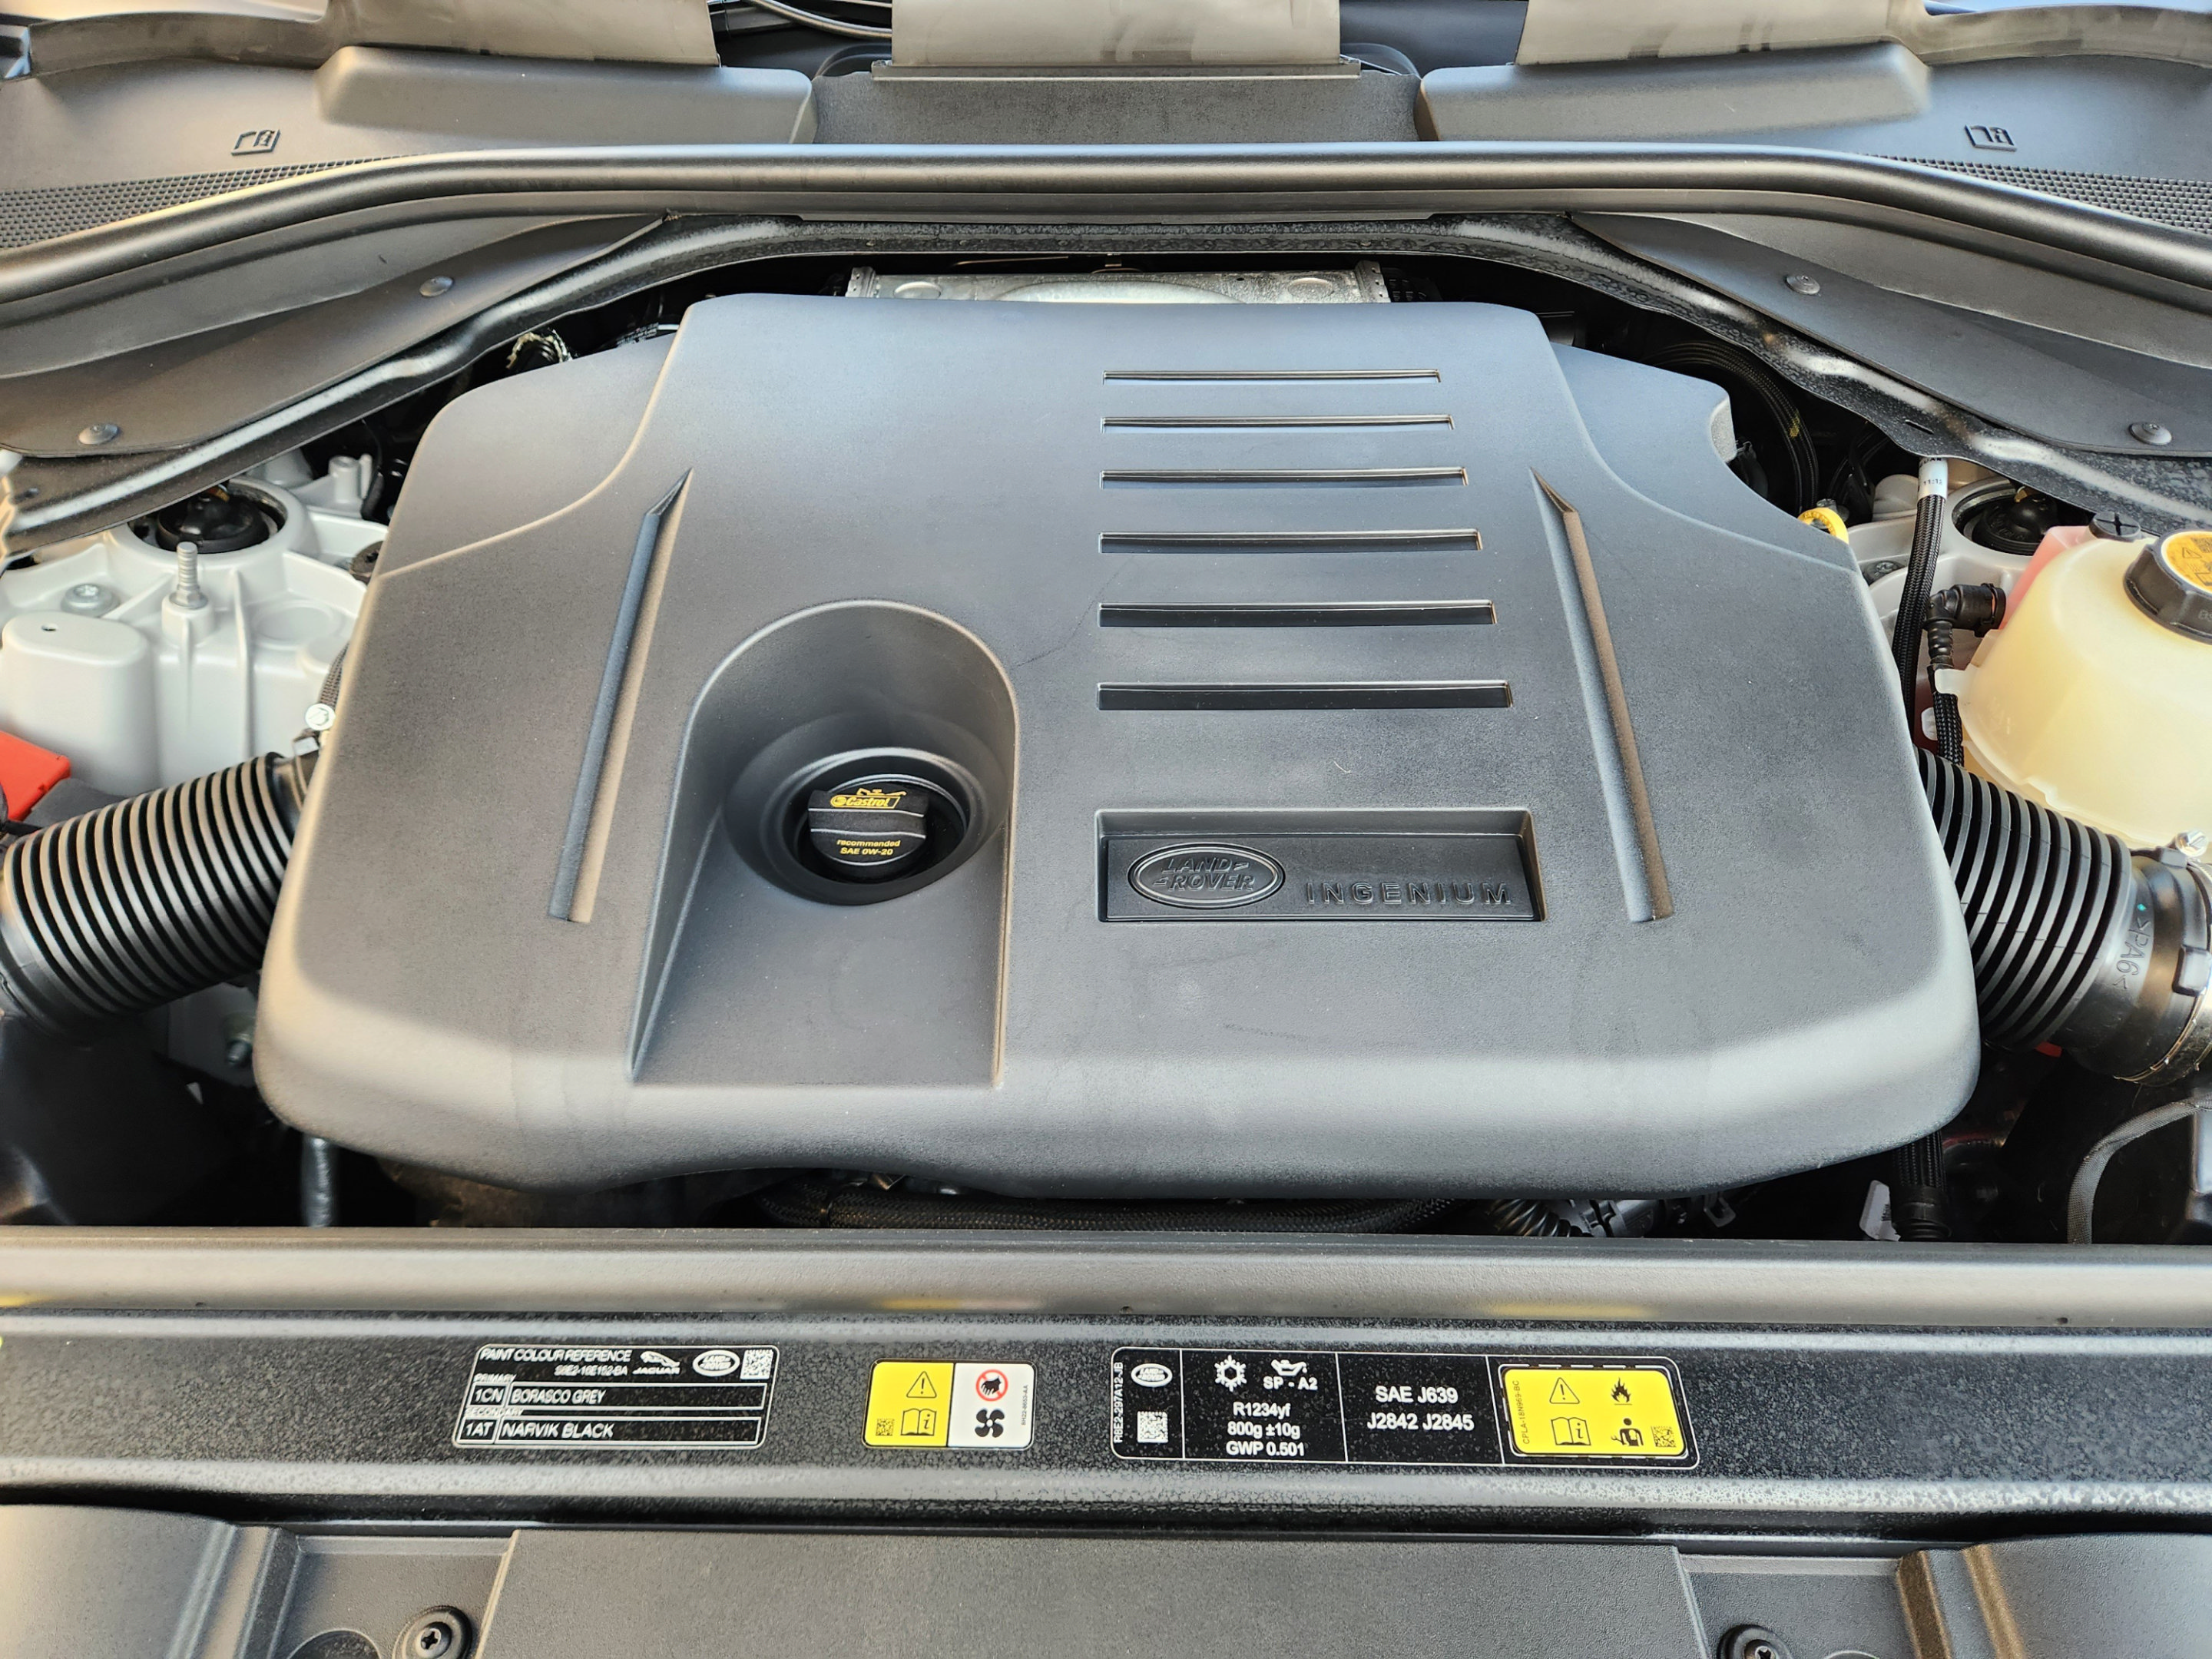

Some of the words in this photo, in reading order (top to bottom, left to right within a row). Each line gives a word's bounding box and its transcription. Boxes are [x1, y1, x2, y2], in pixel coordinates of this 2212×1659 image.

[846, 796, 890, 806] Castrol
[1161, 857, 1232, 873] LAND
[1168, 873, 1255, 892] ROVER
[1306, 882, 1512, 905] INGENIUM
[479, 1348, 515, 1361] PAINT
[513, 1349, 565, 1362] COLOUR
[565, 1349, 633, 1363] REFERENCE
[473, 1373, 516, 1382] PRIMARY
[1263, 1376, 1283, 1389] SP
[1297, 1377, 1318, 1390] A2
[475, 1388, 504, 1402] 1CN
[511, 1389, 571, 1403] BORASCO
[572, 1389, 606, 1403] GREY
[1375, 1386, 1414, 1403] SAE
[1417, 1386, 1459, 1404] J639
[465, 1407, 524, 1416] SECONDARY
[1233, 1402, 1291, 1419] R1234yf
[1367, 1412, 1419, 1429] J2842
[1422, 1413, 1475, 1431] J2845
[465, 1422, 493, 1437] 1AT
[502, 1422, 559, 1438] NARVIK
[561, 1423, 614, 1439] BLACK
[1227, 1421, 1263, 1439] 800g
[1265, 1422, 1300, 1439] ±10g
[1226, 1441, 1263, 1455] GWP
[1266, 1441, 1304, 1456] 0.501
